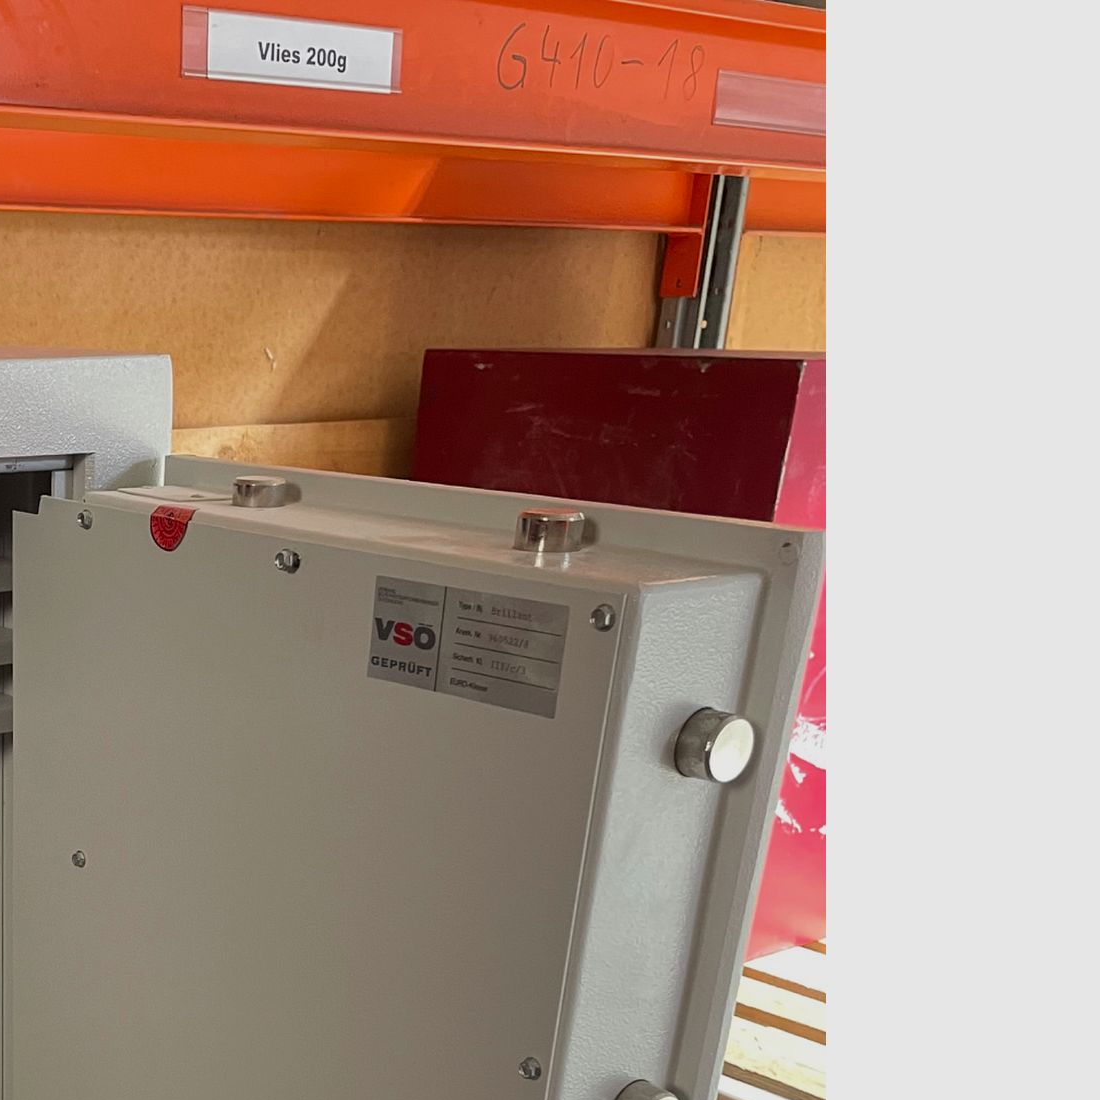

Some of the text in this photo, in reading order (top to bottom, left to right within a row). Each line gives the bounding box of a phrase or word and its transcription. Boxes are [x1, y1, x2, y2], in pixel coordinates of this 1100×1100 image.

[258, 41, 347, 73] Vlies 200g
[375, 617, 436, 650] VSÖ
[371, 656, 432, 678] GEPRÜFT
